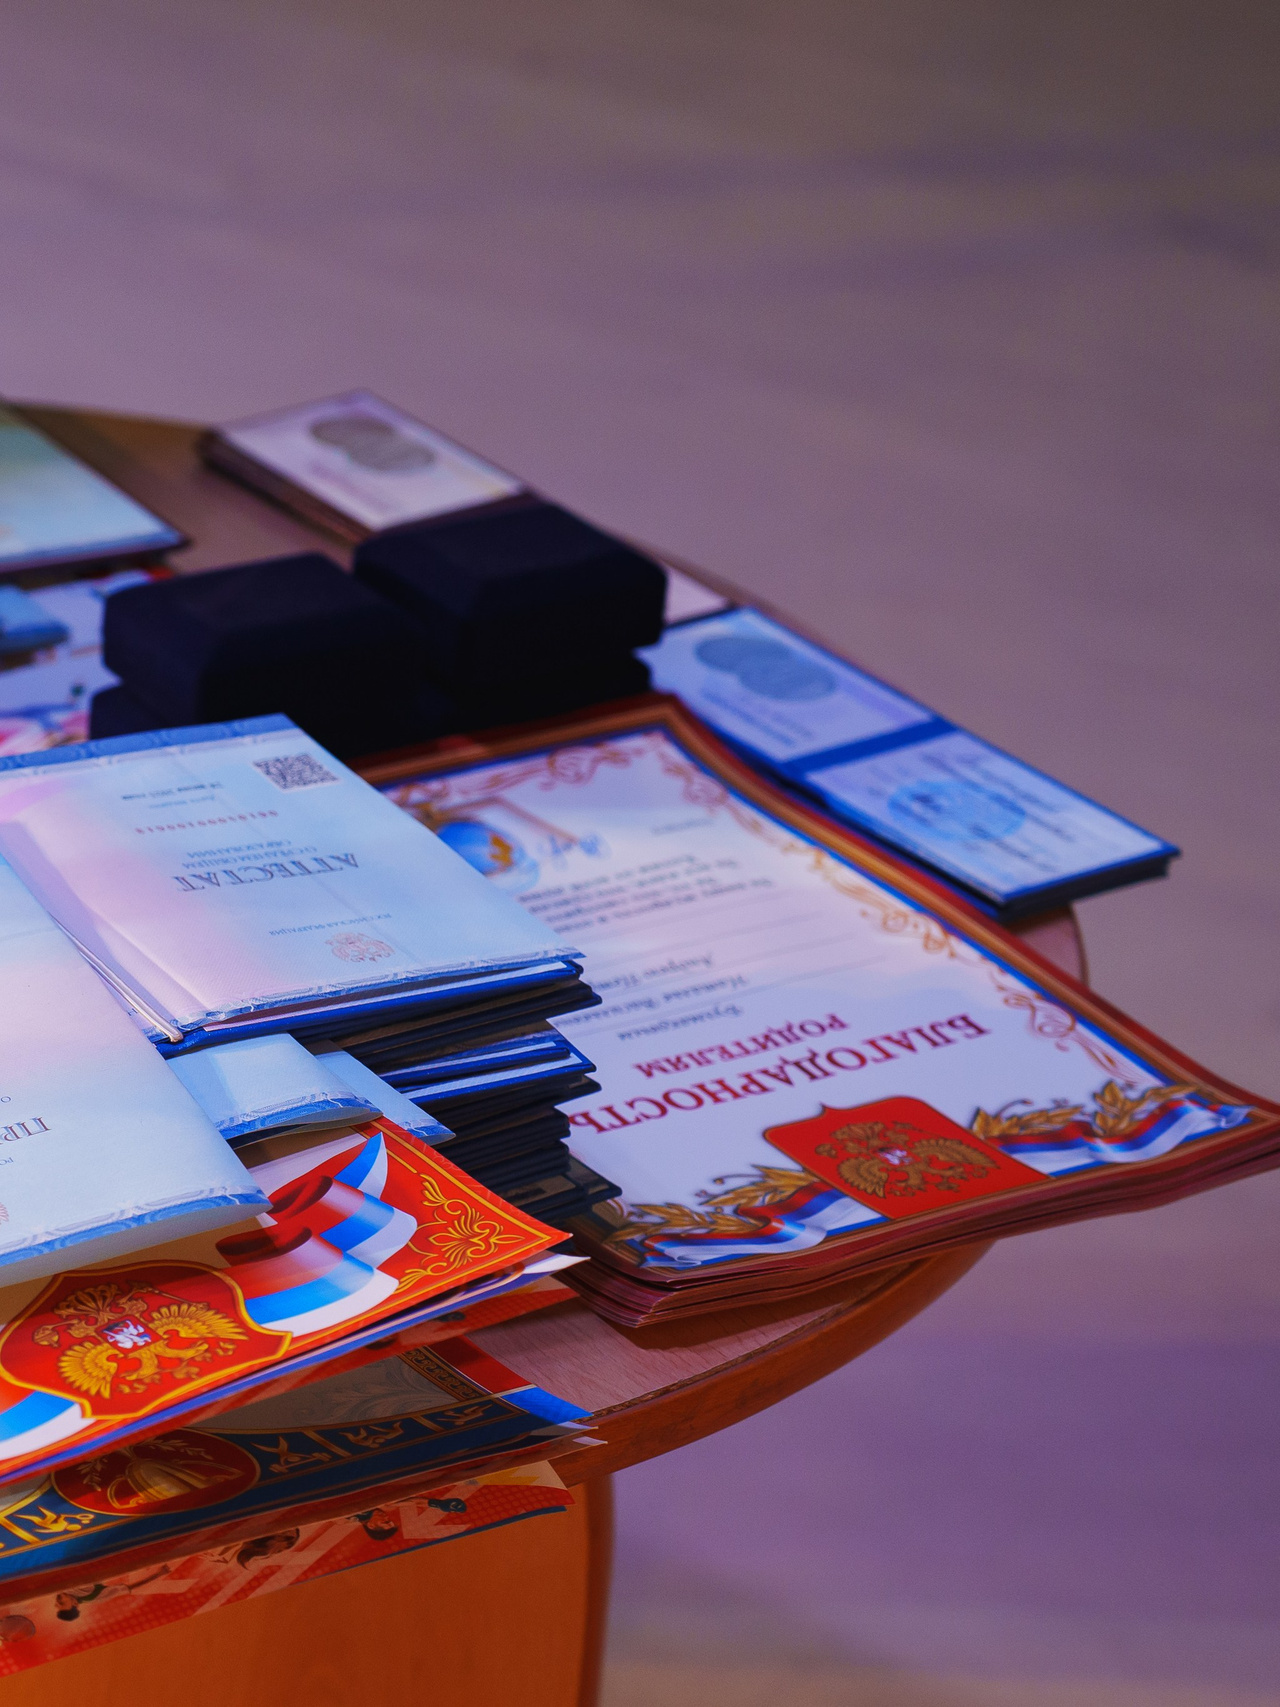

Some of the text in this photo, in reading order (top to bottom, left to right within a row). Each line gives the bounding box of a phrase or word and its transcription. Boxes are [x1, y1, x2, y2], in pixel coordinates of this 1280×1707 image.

[171, 852, 359, 892] АТТЕСТАТ
[630, 1013, 850, 1080] РОДИТЕЛЯМ
[0, 1095, 12, 1104] О
[567, 1013, 992, 1134] БЛАГОДАРНОСТЬ
